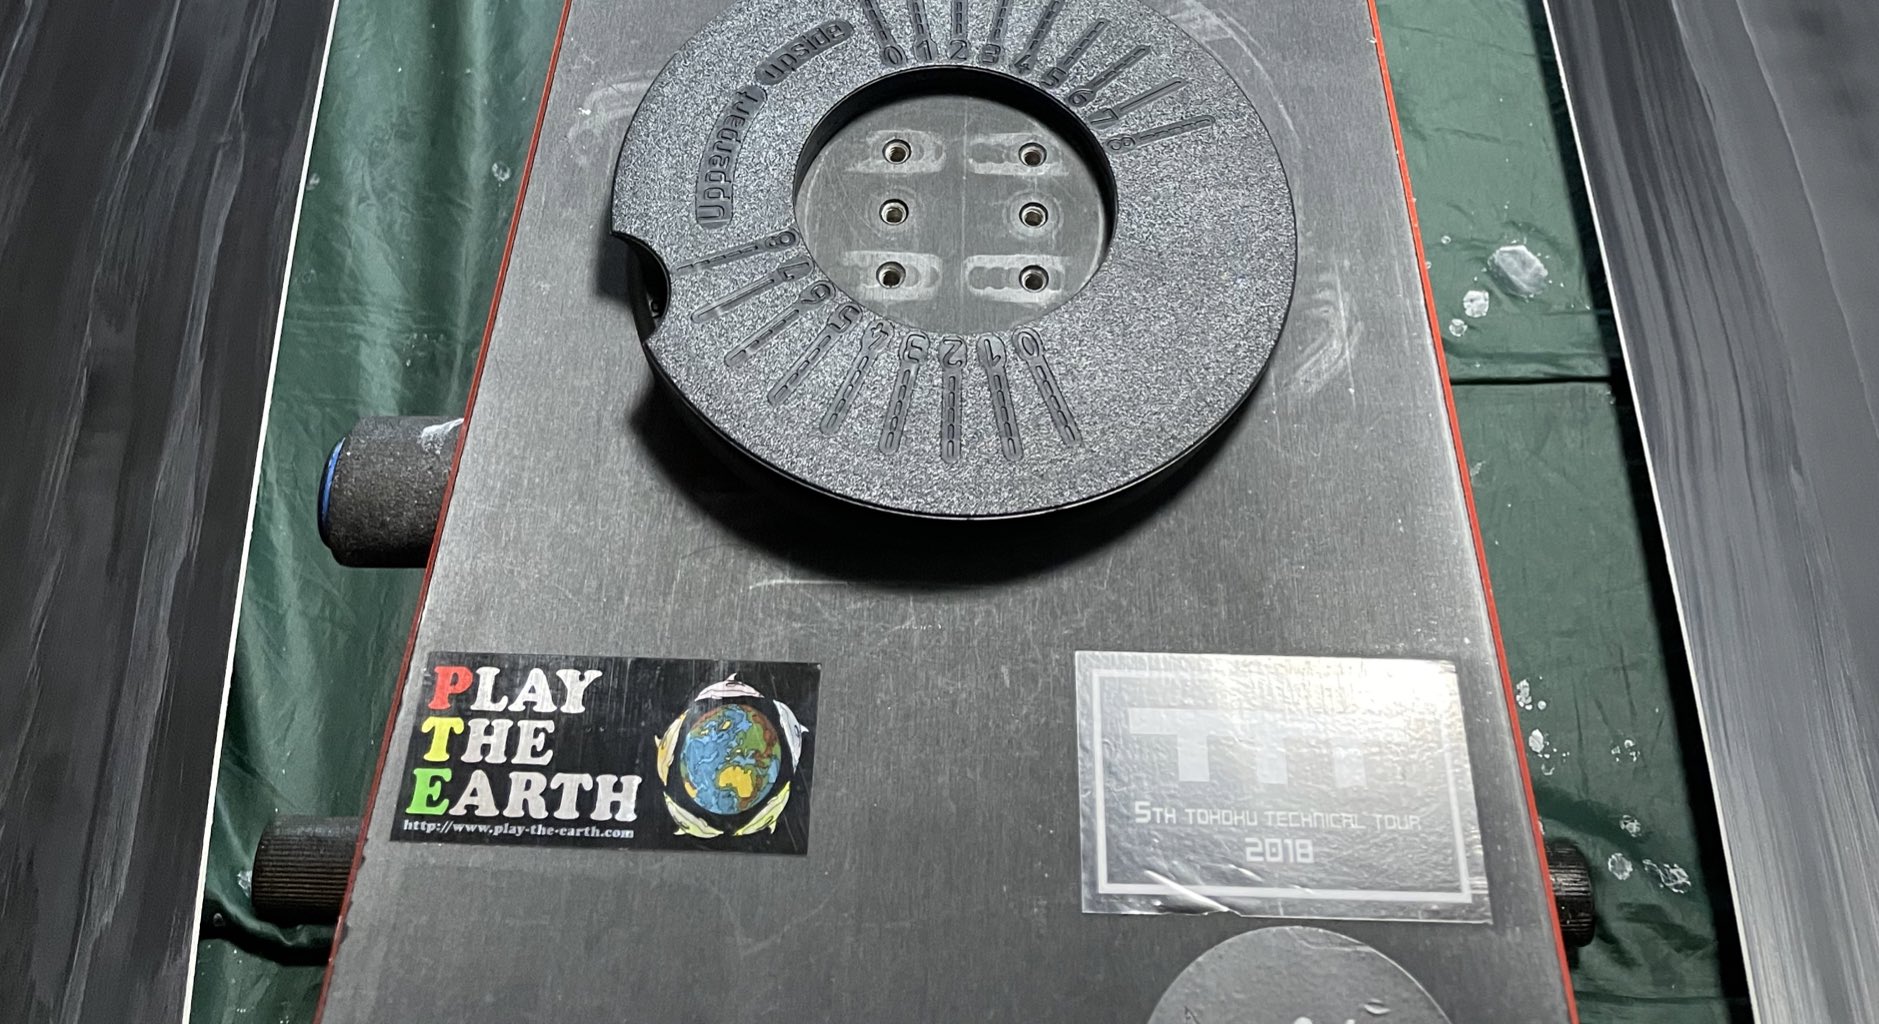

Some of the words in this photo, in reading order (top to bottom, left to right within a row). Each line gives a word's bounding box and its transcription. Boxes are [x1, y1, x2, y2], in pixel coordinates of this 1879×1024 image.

[883, 44, 904, 65] 0
[916, 38, 933, 62] 1
[949, 38, 968, 61] 2
[1017, 330, 1040, 358] 0
[427, 665, 604, 714] PLAY
[421, 716, 556, 766] THE
[405, 767, 643, 823] EARTH
[403, 819, 635, 840] http://www.play-the-earth.com
[1134, 801, 1177, 824] 5TH
[1184, 808, 1258, 826] TOHOKU
[1264, 810, 1367, 830] TECHNICAL
[1374, 813, 1422, 831] TOUR
[1245, 837, 1315, 864] 2018
